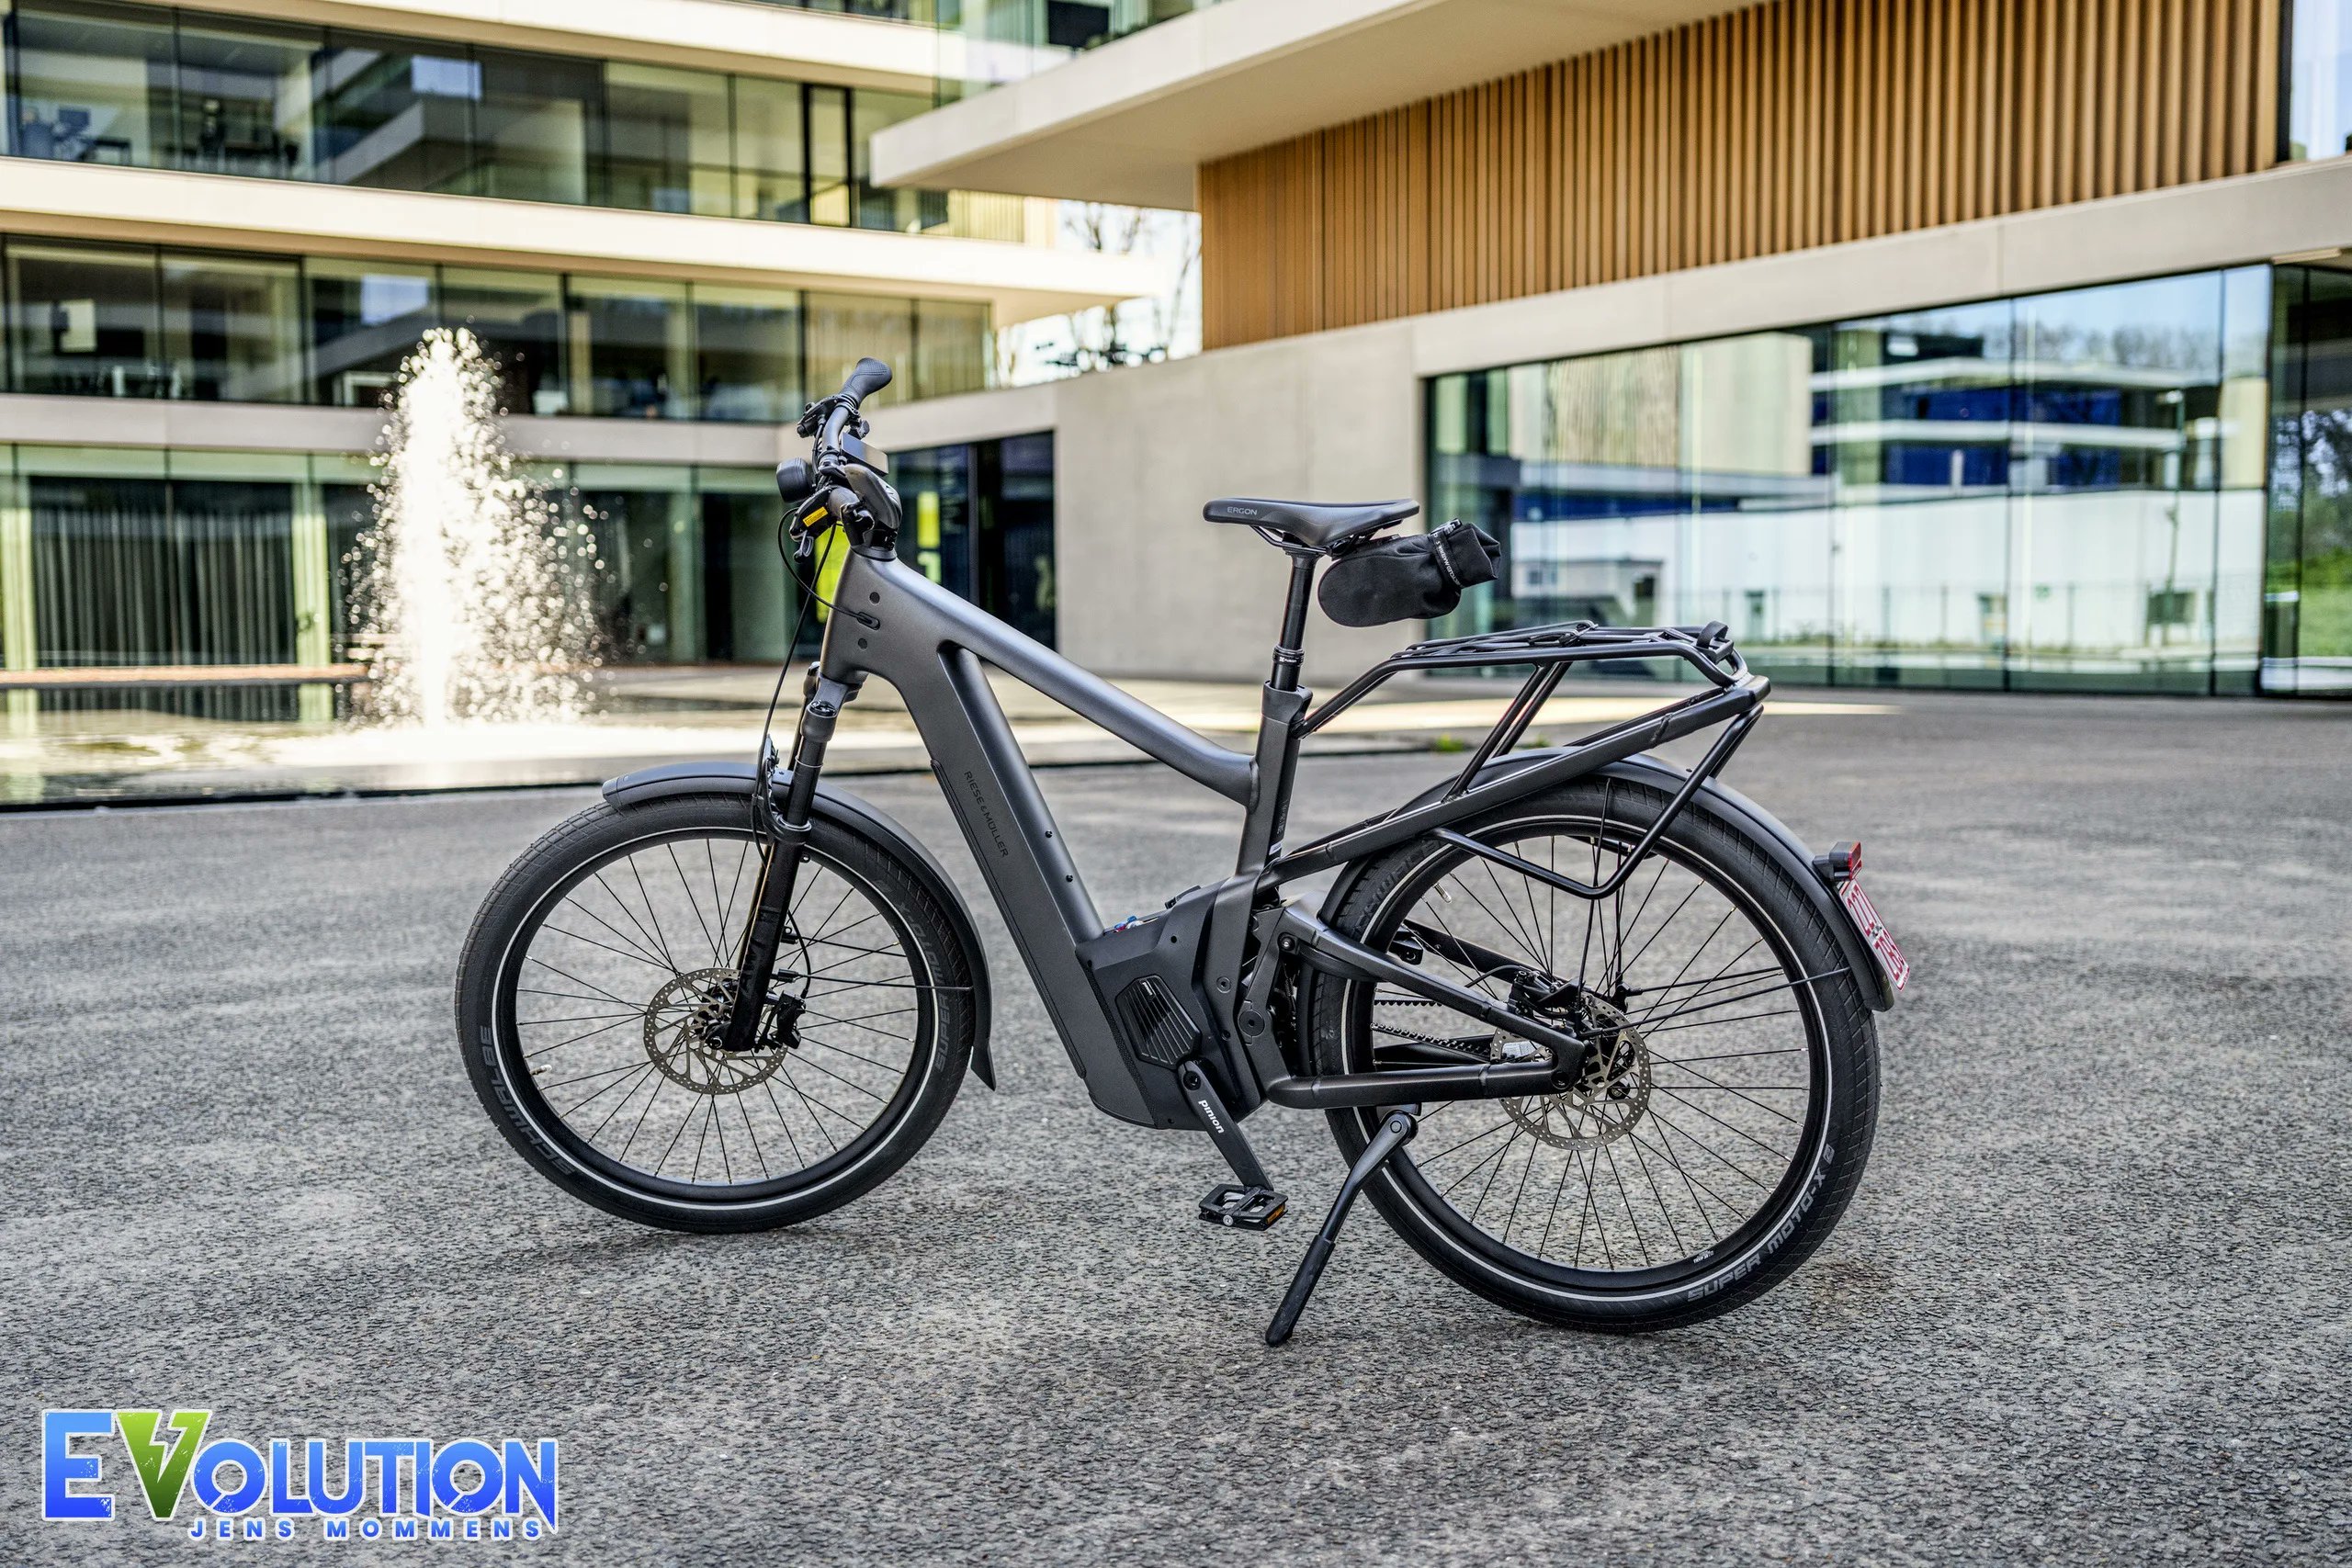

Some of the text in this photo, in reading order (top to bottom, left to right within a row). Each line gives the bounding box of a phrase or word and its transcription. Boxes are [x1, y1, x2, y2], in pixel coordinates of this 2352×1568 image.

[1227, 506, 1258, 515] ERGON
[964, 771, 985, 805] RIESE
[934, 993, 951, 1072] SUPER
[480, 1025, 576, 1175] SCHWALBE
[1198, 1099, 1225, 1134] pinion
[1687, 1167, 1826, 1303] SUPER MOTO-X
